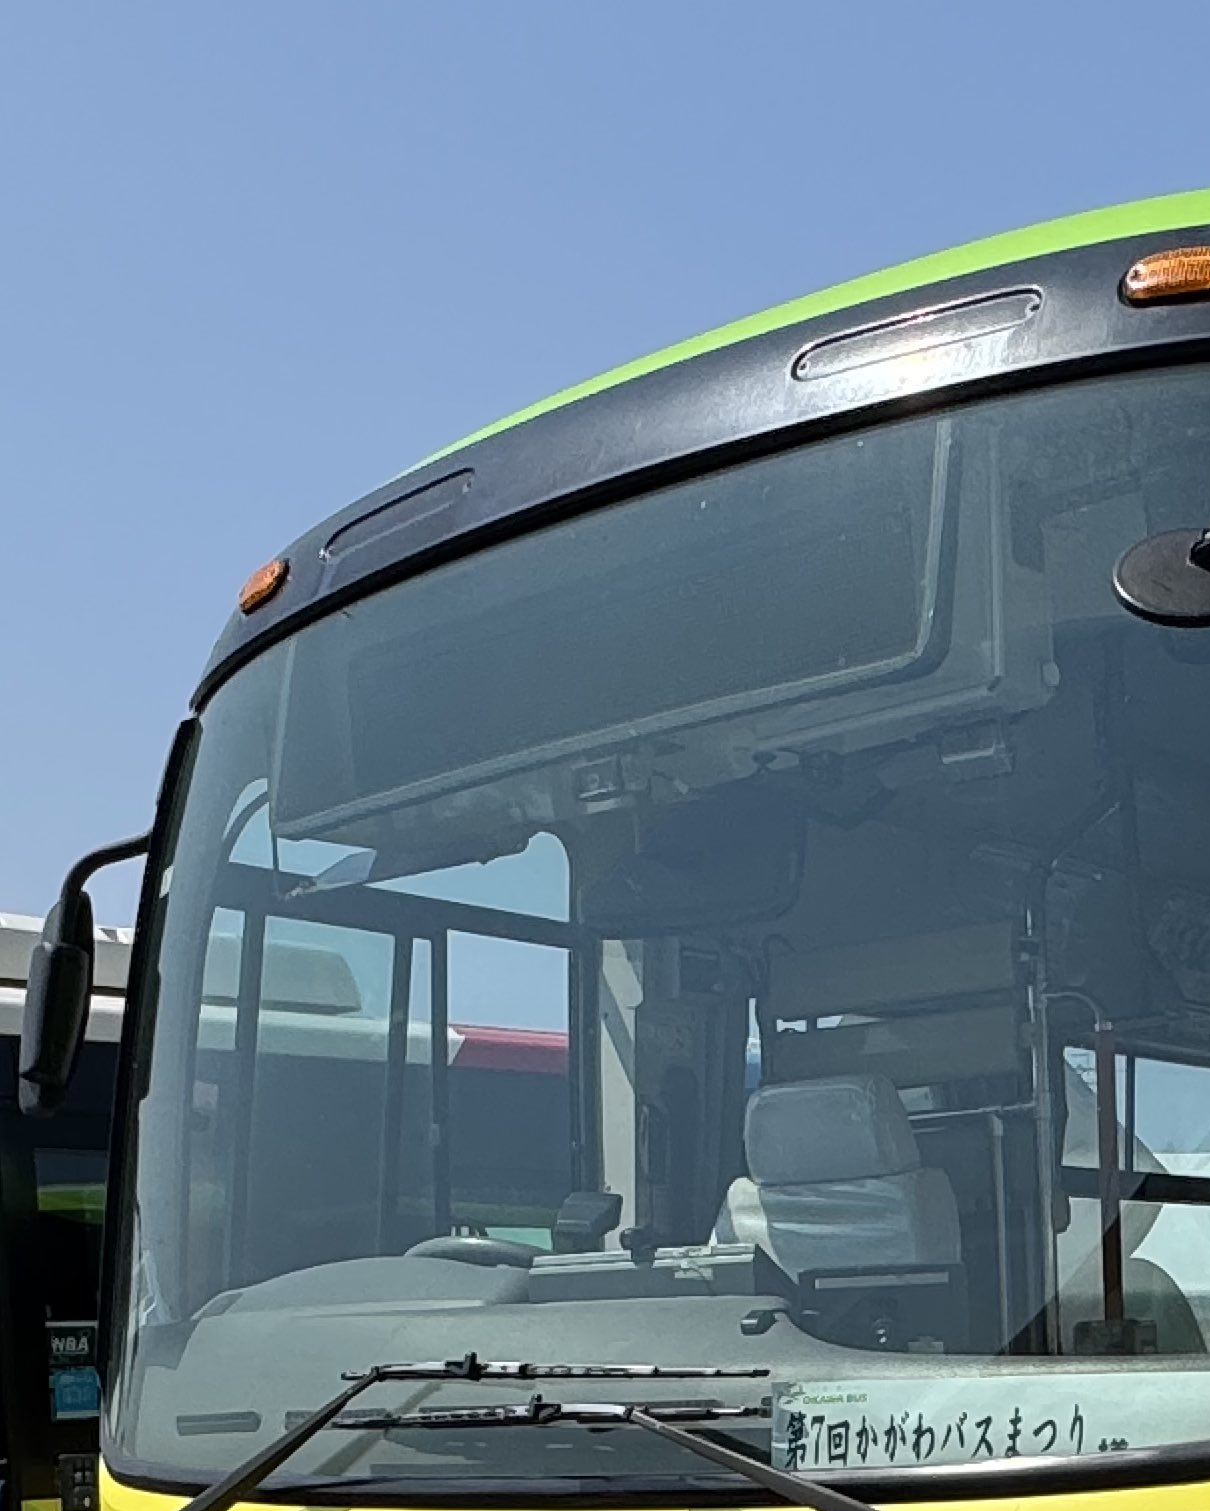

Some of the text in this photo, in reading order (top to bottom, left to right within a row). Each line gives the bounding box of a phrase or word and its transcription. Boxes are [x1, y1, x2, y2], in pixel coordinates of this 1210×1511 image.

[847, 1394, 868, 1402] BUS
[785, 1404, 1084, 1469] 第7回かがわバスまつり
